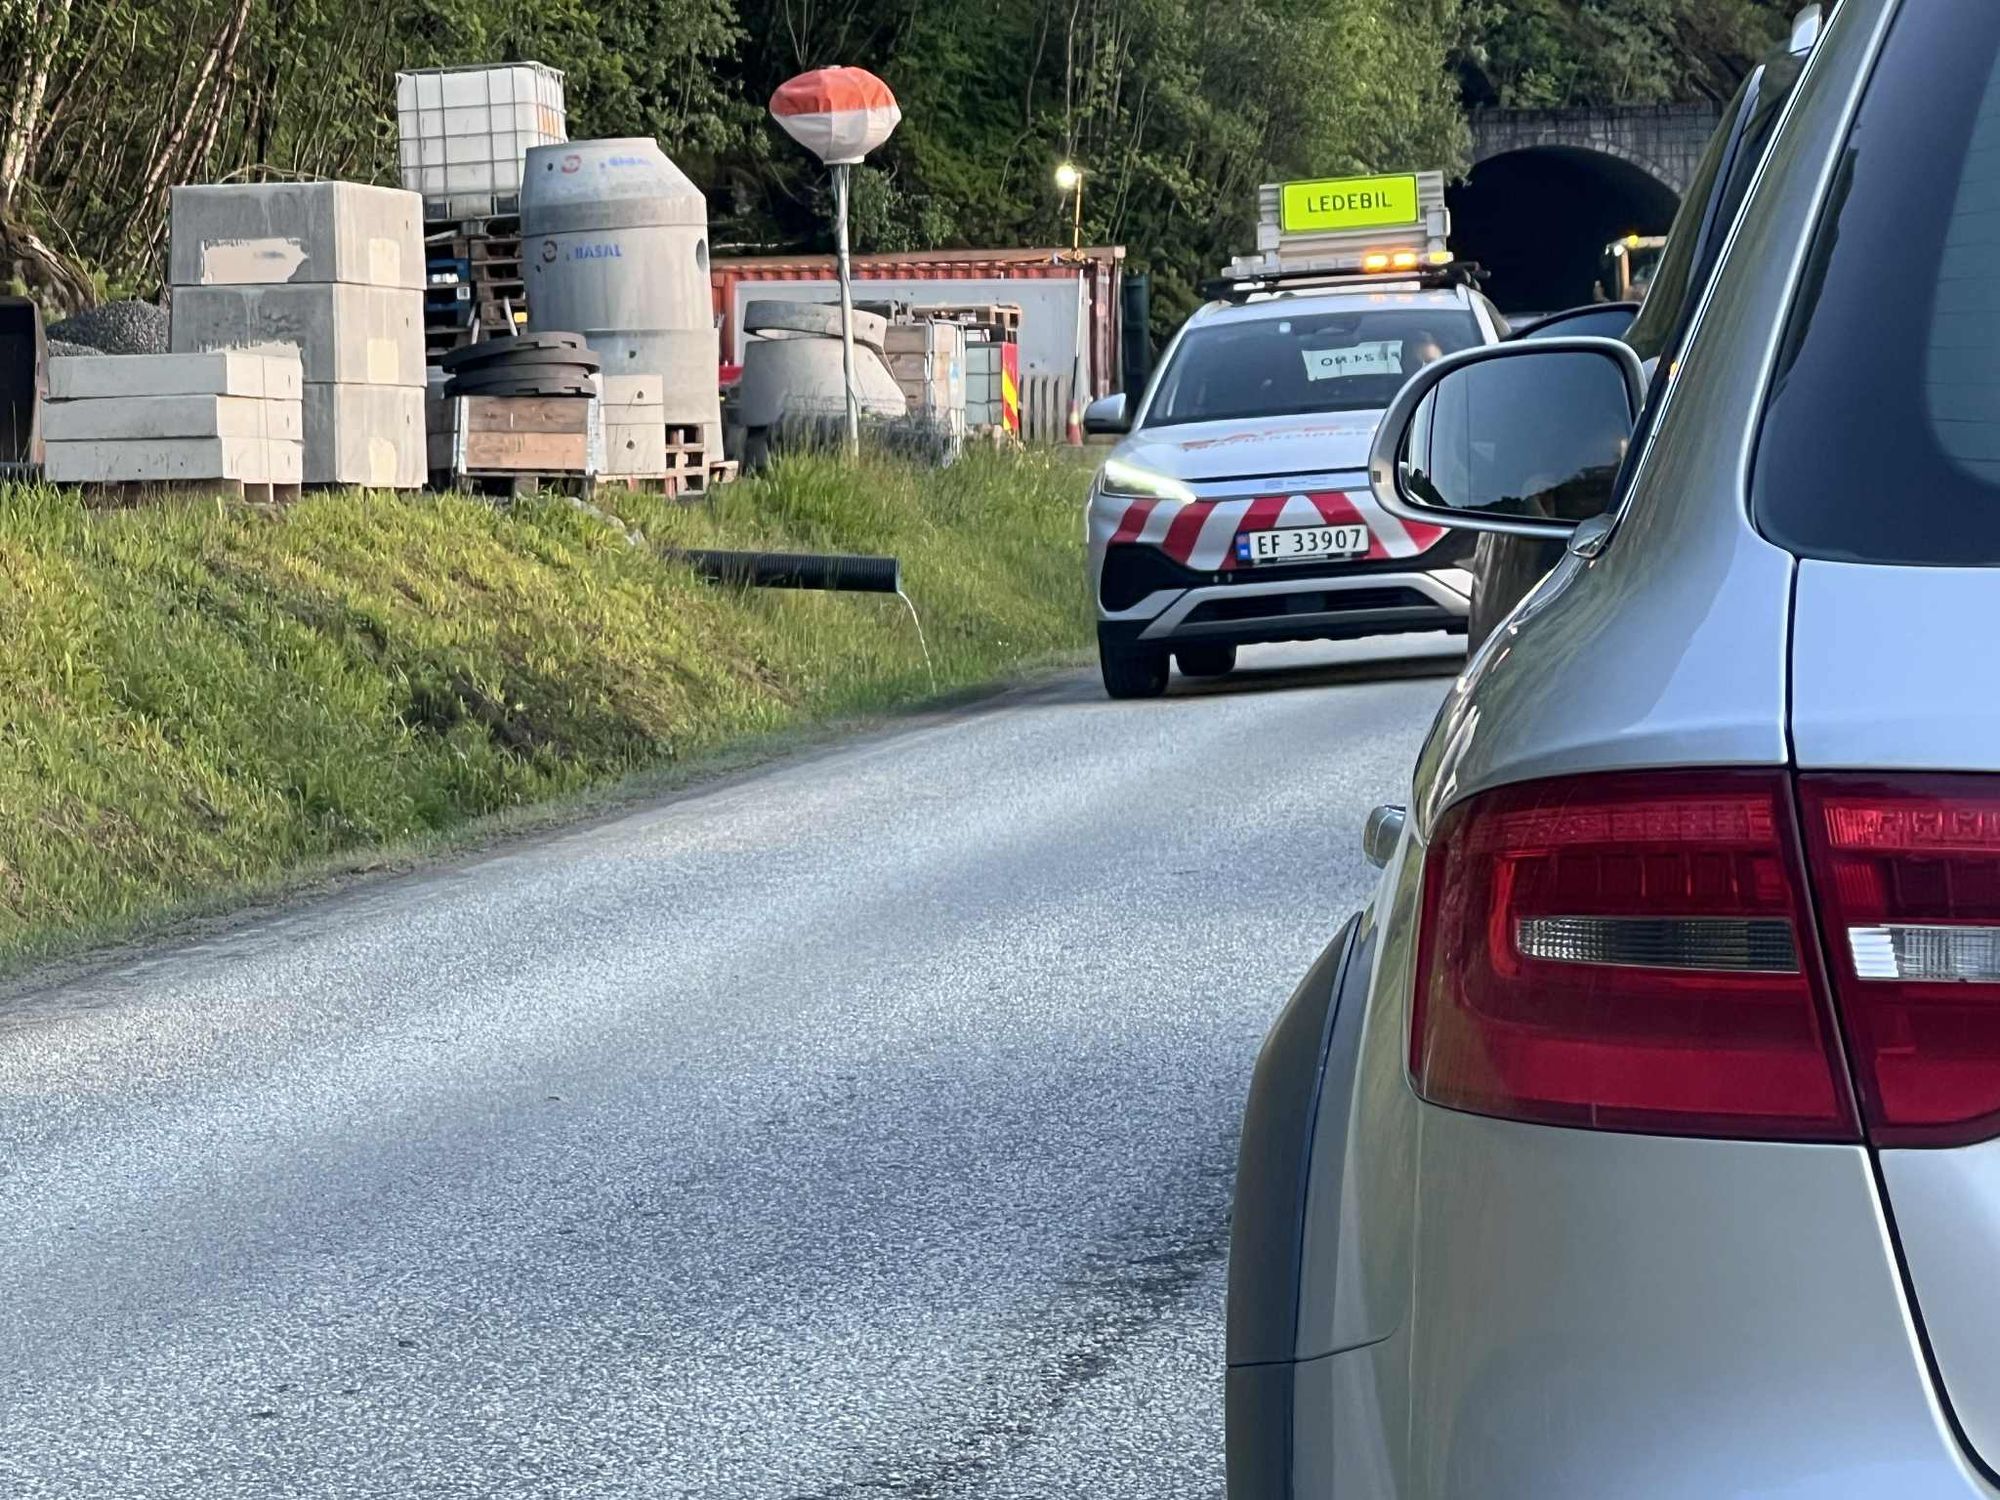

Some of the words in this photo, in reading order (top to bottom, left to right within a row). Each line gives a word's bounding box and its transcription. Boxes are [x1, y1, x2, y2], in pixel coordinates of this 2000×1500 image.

[1307, 191, 1392, 213] LEDEBIL
[1257, 534, 1280, 555] EF
[1293, 528, 1361, 553] 33907
